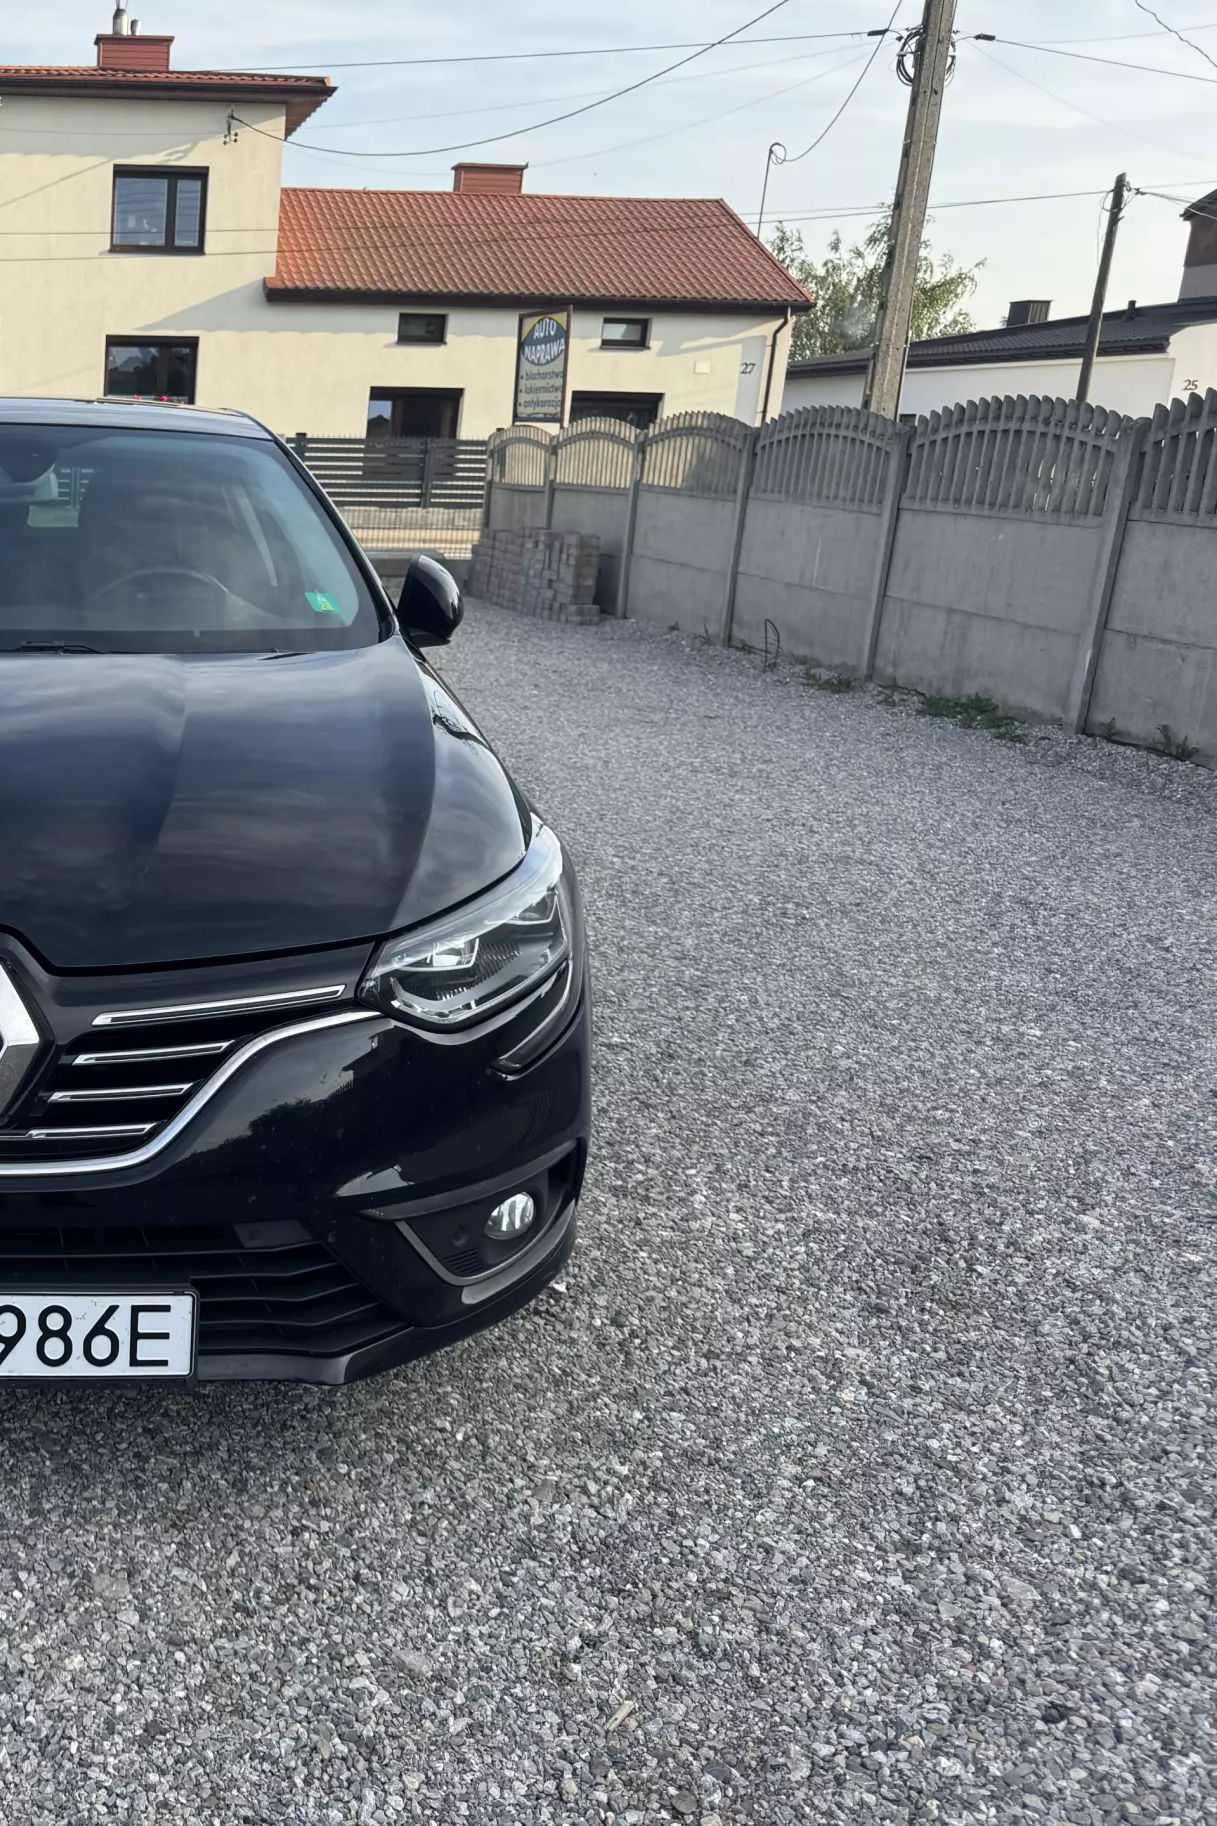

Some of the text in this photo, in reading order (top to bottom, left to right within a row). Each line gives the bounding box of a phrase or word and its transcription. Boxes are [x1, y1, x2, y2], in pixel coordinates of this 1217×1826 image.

[534, 318, 557, 340] AUTO
[524, 339, 566, 364] NAPRAWA
[740, 362, 756, 375] 27
[1182, 379, 1199, 391] 25
